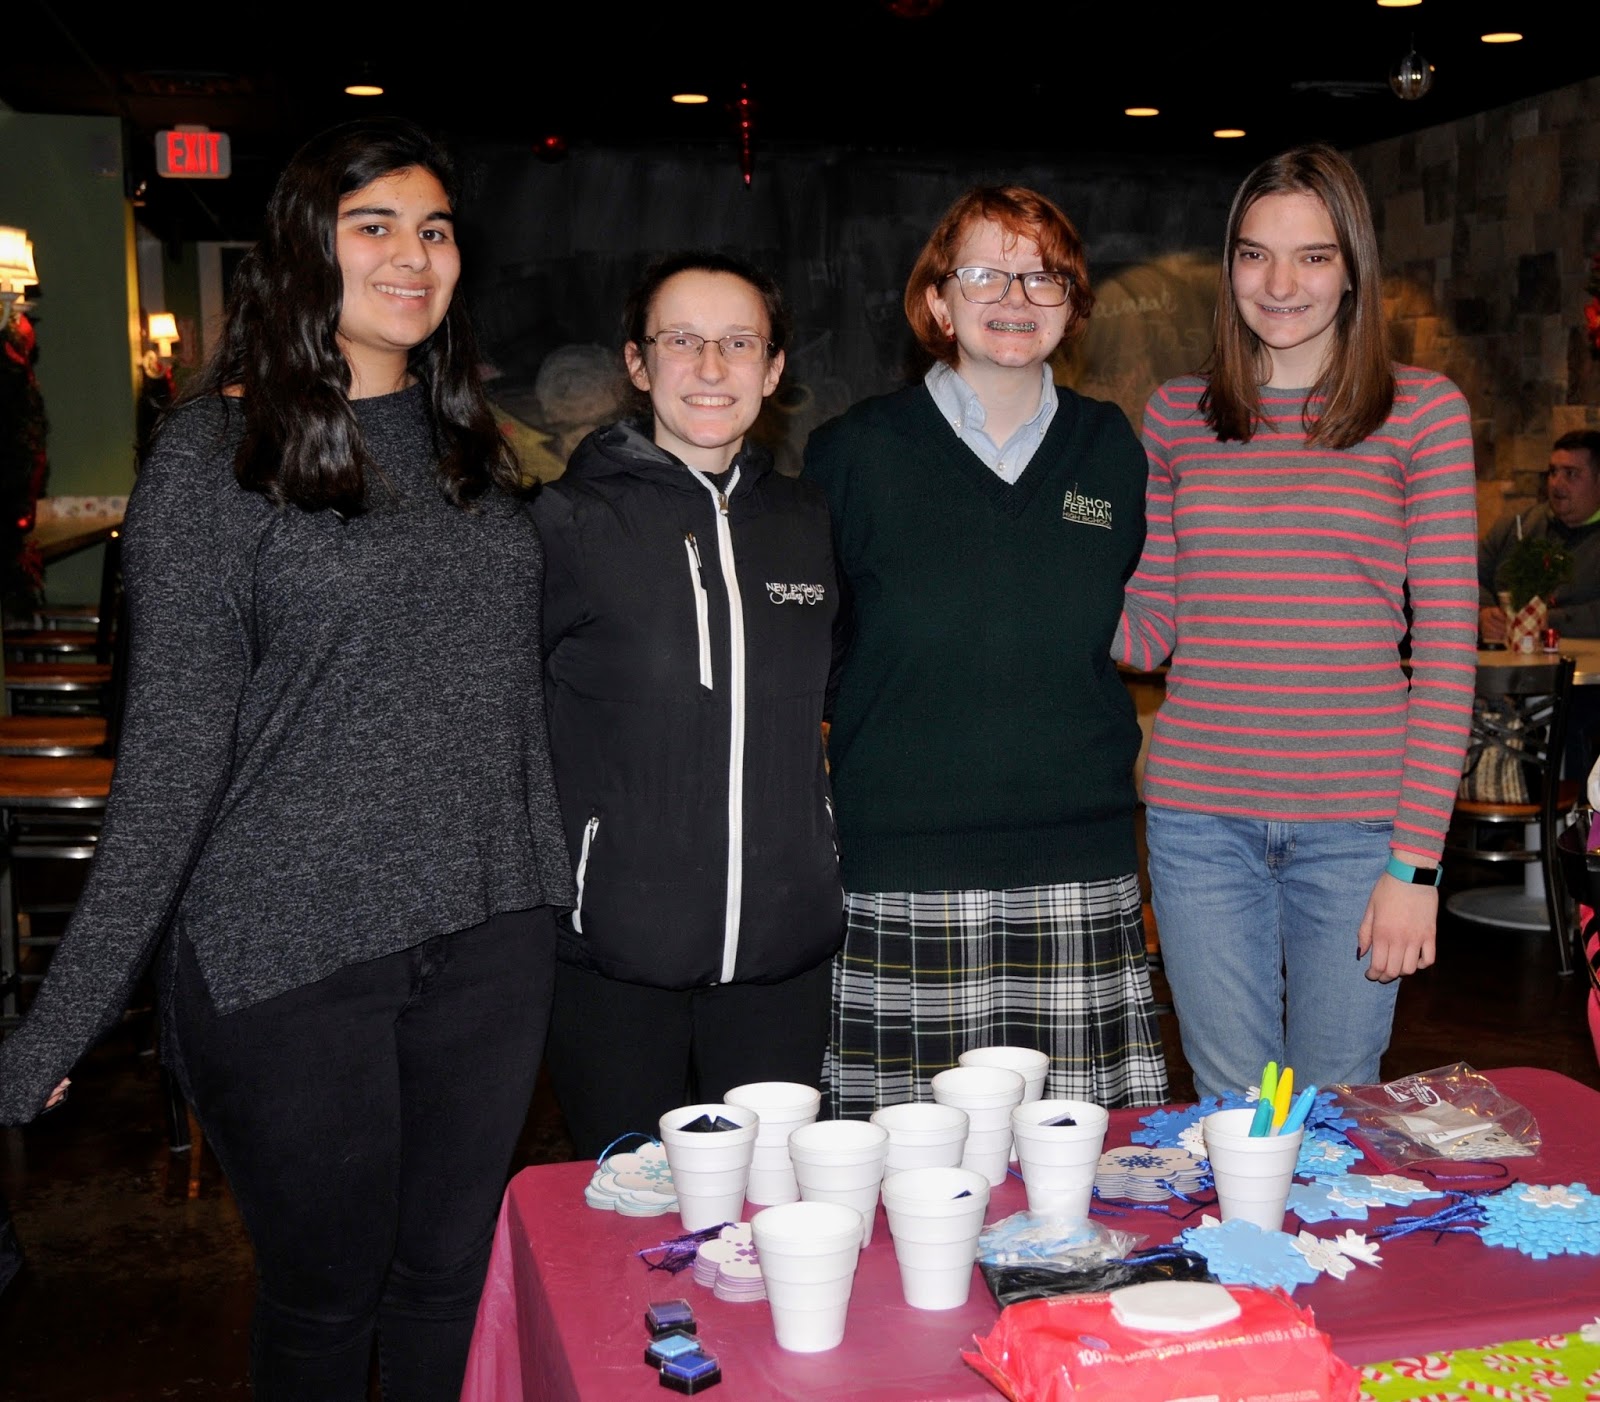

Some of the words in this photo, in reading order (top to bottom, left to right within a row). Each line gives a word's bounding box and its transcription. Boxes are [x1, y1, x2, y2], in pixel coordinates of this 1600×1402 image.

[167, 131, 221, 174] EXIT
[1064, 483, 1112, 509] BISHOP
[1062, 500, 1112, 522] FEEHAN
[765, 582, 787, 592] NEW
[1077, 1348, 1103, 1366] 100
